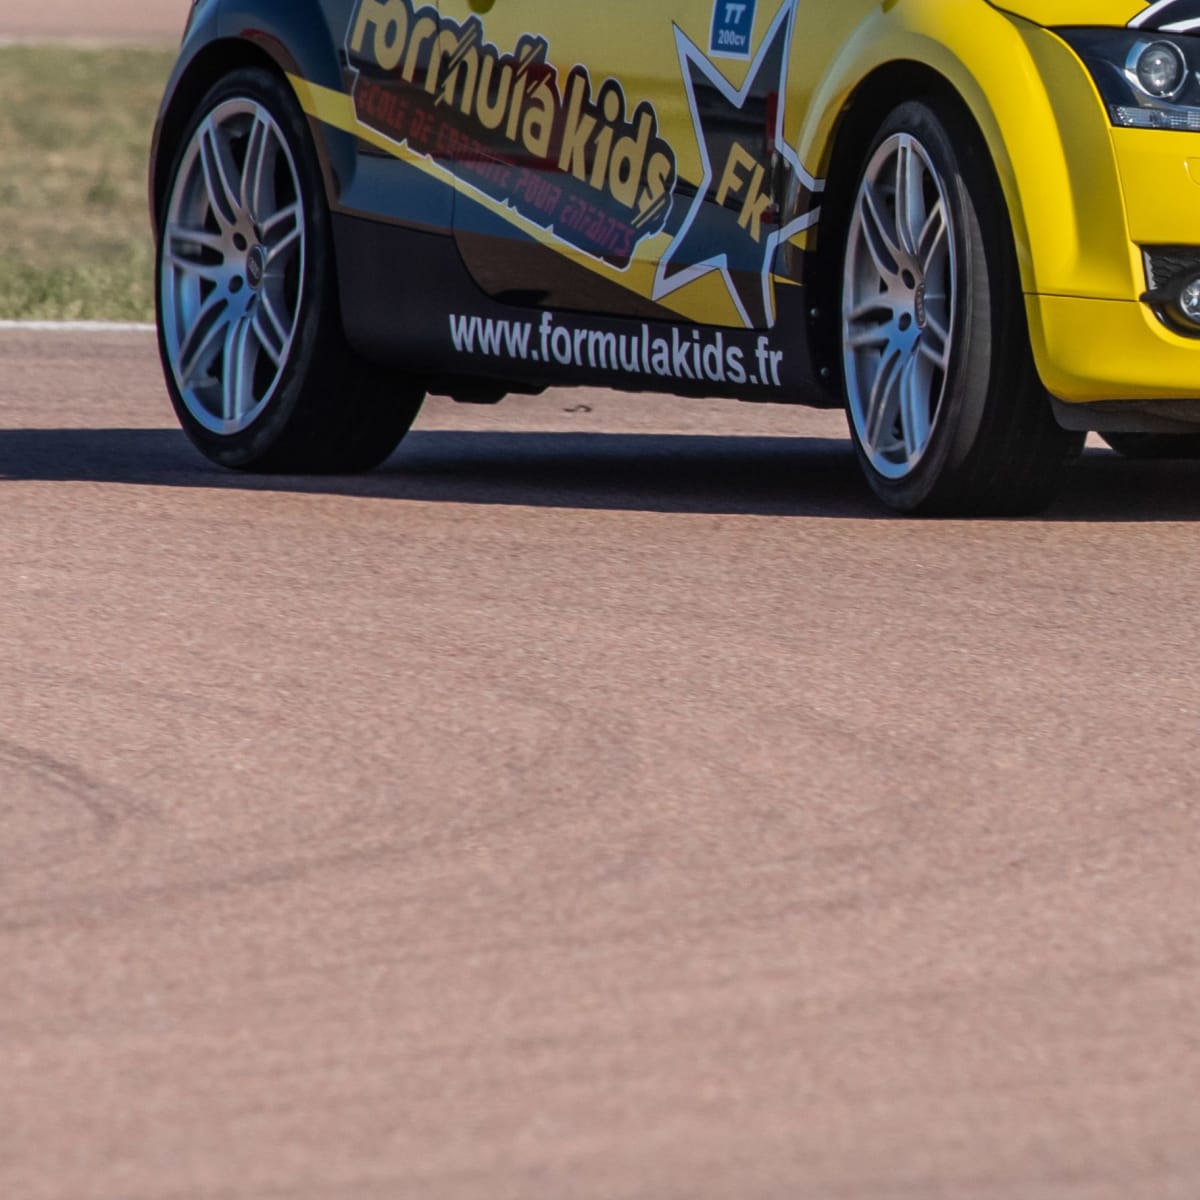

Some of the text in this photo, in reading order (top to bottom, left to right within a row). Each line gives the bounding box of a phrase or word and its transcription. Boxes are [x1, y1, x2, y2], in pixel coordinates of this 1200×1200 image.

[717, 29, 746, 47] 200cv
[725, 3, 747, 25] TT
[558, 74, 671, 229] kids
[449, 311, 783, 386] www.formulakids.fr
